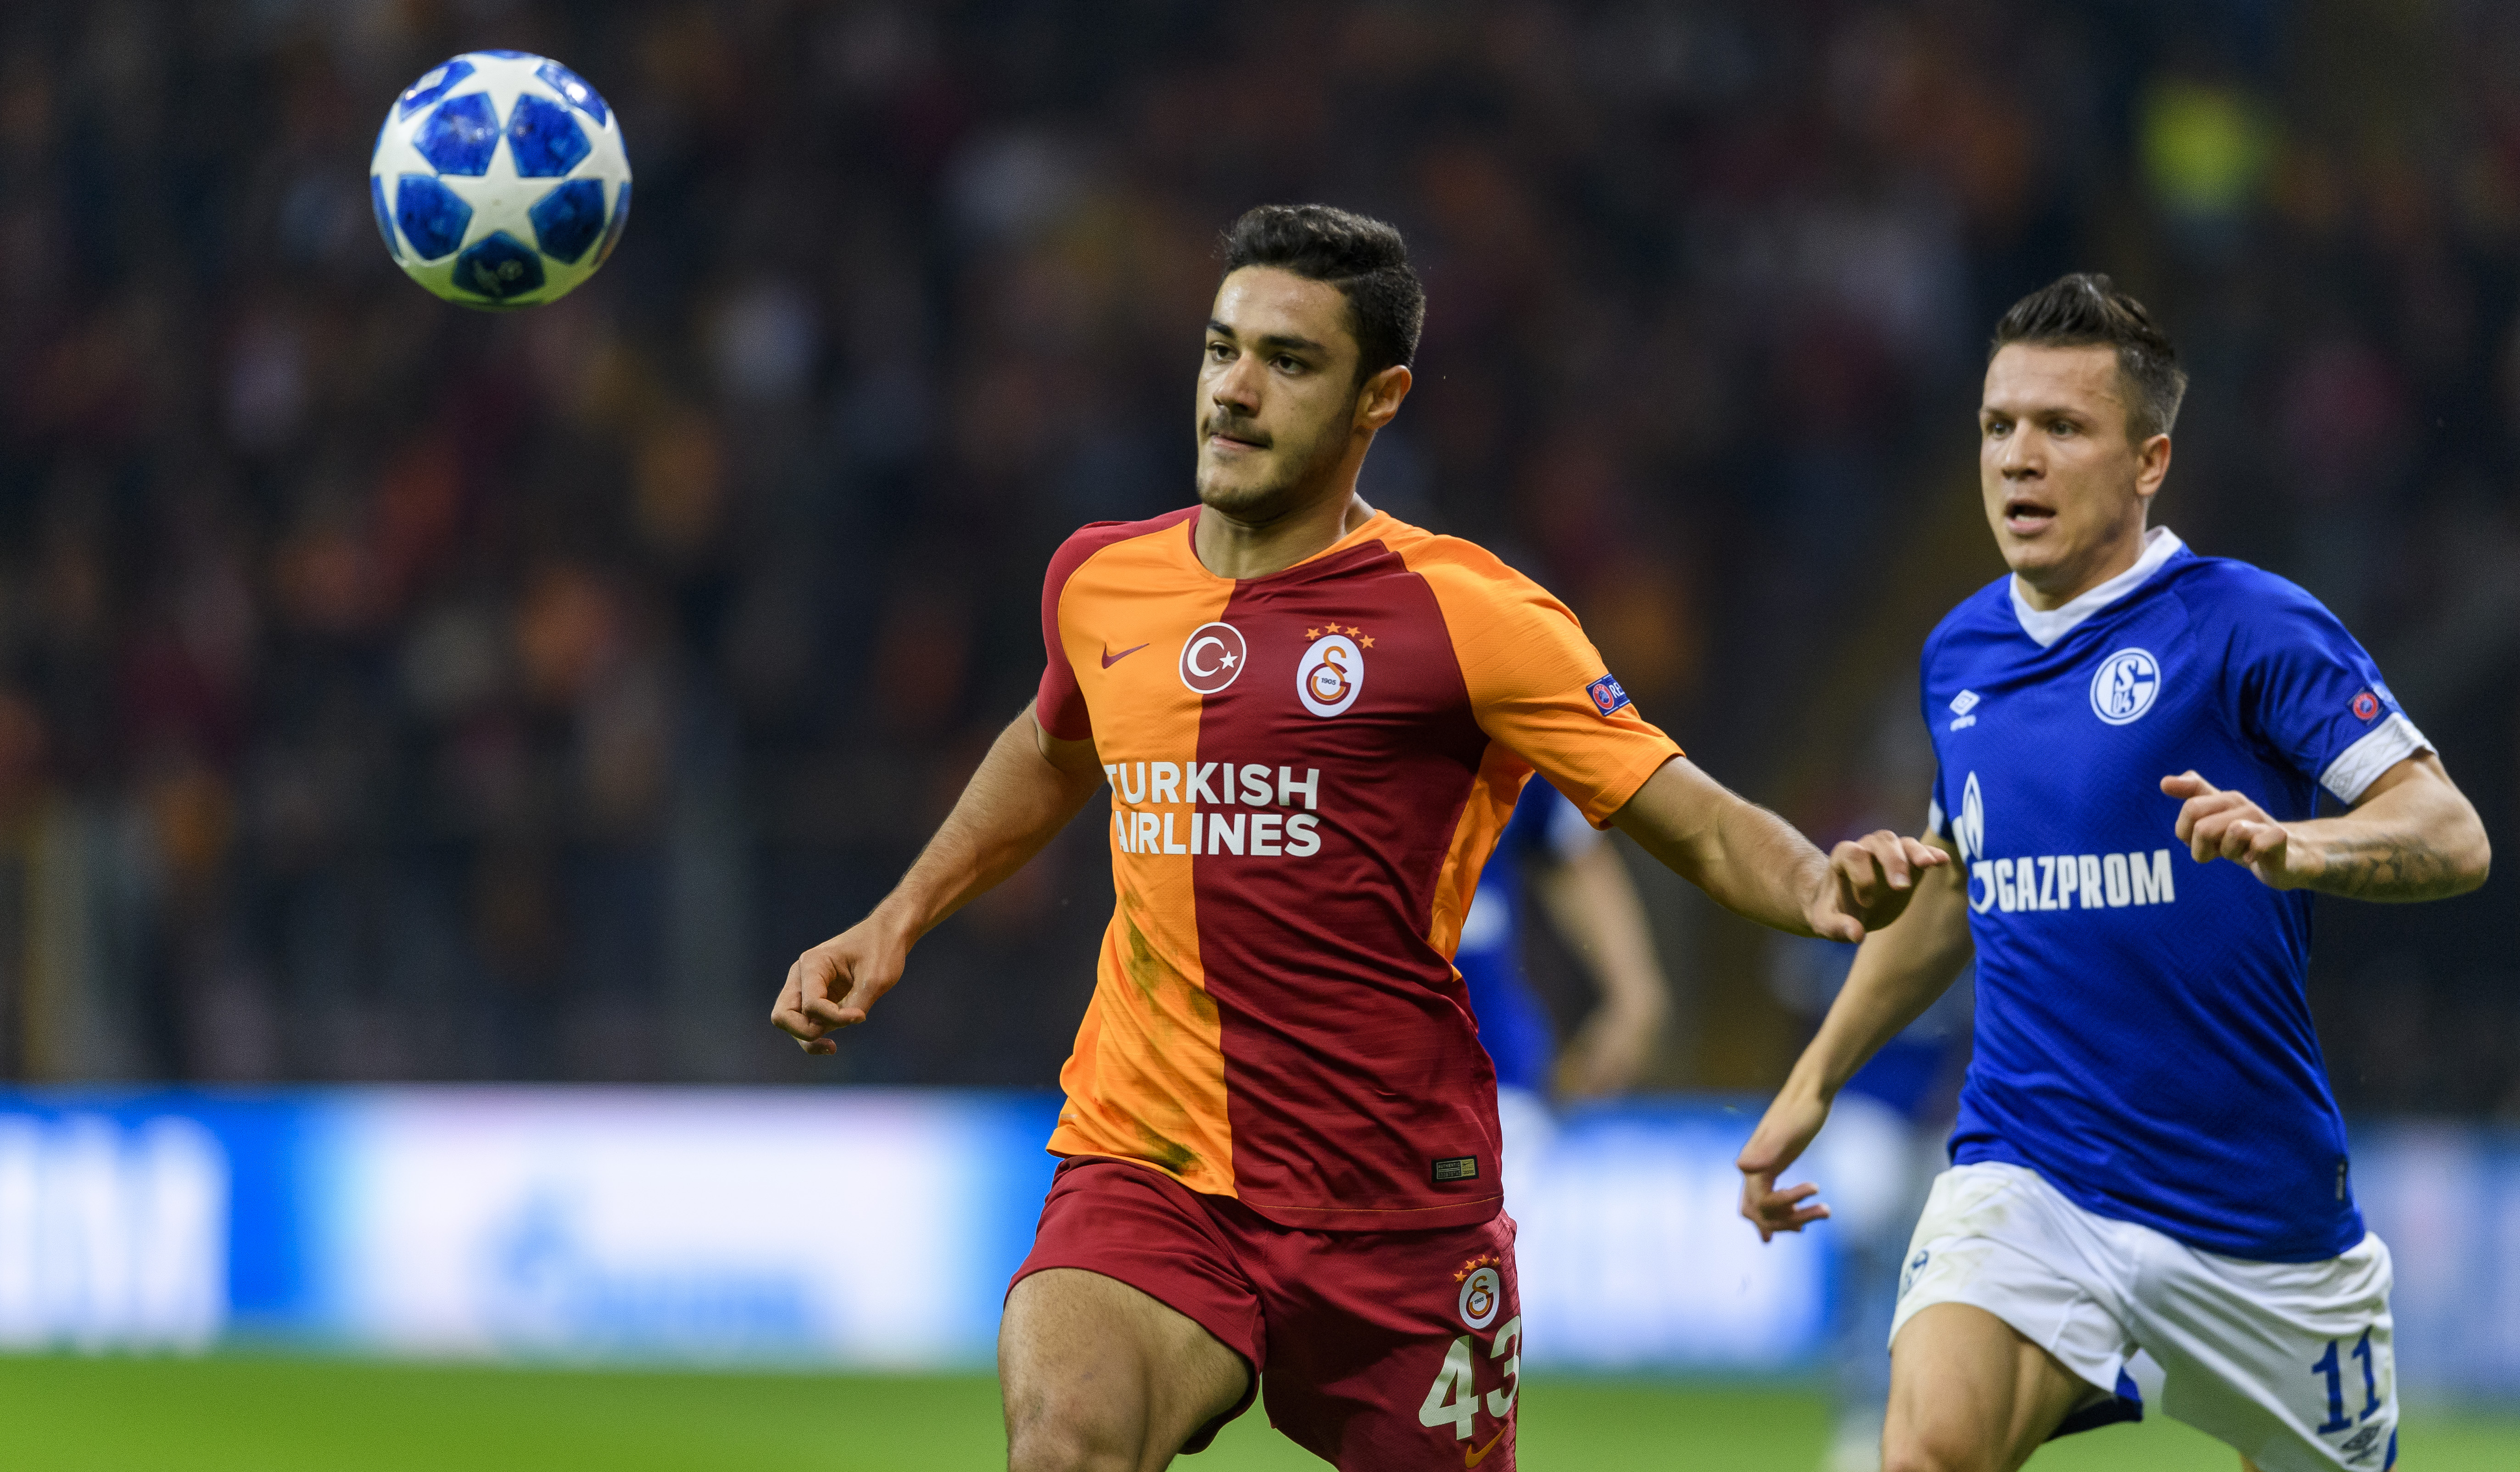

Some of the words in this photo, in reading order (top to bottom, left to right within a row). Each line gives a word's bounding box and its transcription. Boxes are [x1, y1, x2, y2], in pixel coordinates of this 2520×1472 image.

[1103, 761, 1320, 810] TURKISH
[1115, 810, 1322, 857] AIRLINES
[1994, 849, 2176, 914] GAZPROM
[1419, 1315, 1521, 1441] 43
[2311, 1324, 2381, 1435] 11
